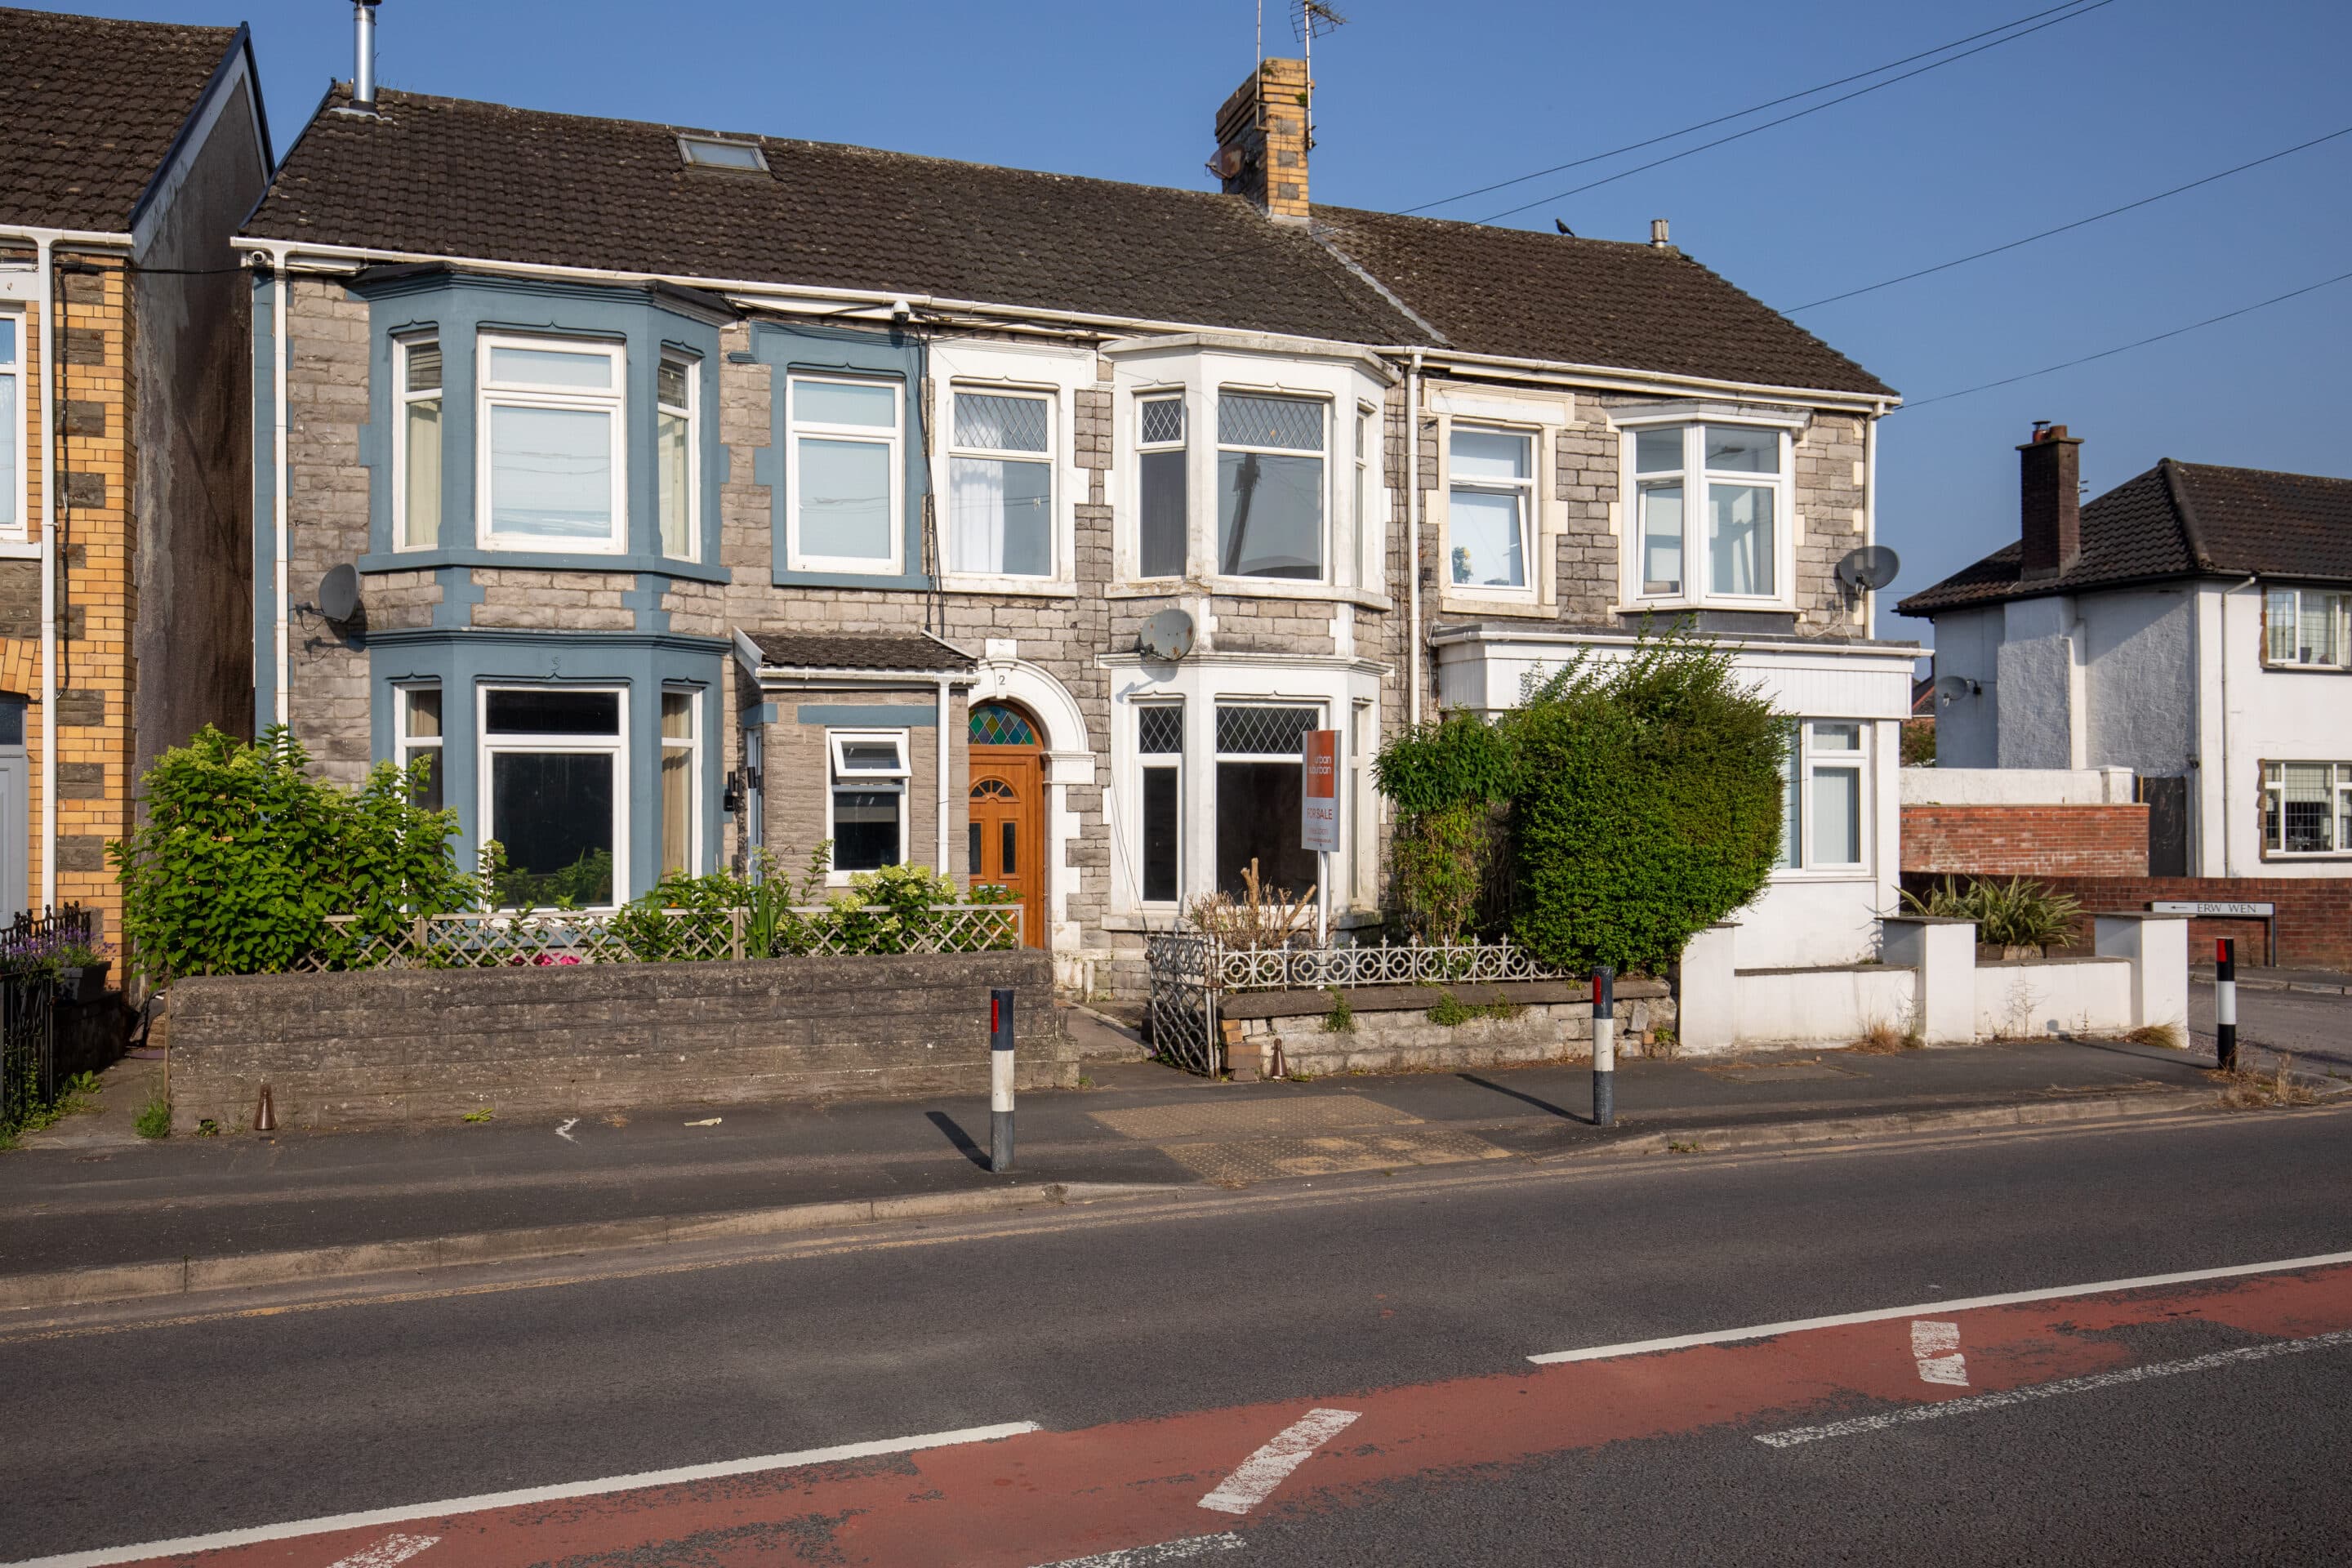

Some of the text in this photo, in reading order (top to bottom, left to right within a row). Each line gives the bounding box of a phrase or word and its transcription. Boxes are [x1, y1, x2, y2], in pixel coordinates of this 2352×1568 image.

[998, 675, 1006, 686] 2
[1314, 754, 1332, 764] urban
[1307, 807, 1333, 821] FOR SALE
[2197, 903, 2256, 913] ERW WEN
